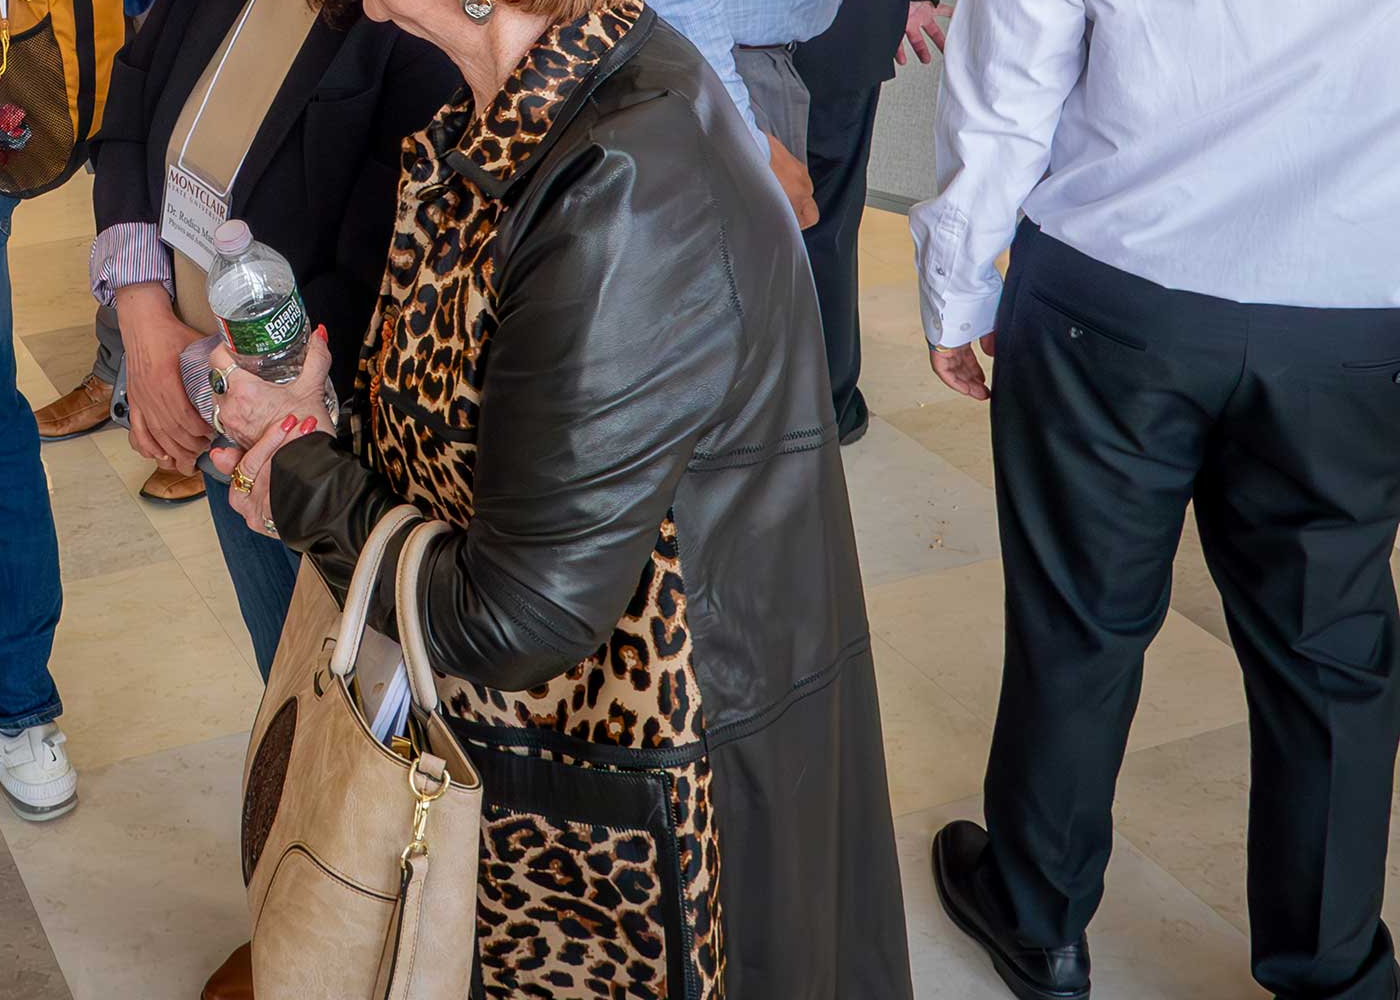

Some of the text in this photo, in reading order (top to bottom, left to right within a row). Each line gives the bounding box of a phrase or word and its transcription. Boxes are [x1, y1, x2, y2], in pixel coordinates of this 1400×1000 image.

[171, 170, 225, 220] MONTCLAIR
[264, 296, 297, 336] Poland
[271, 305, 301, 344] Spring
